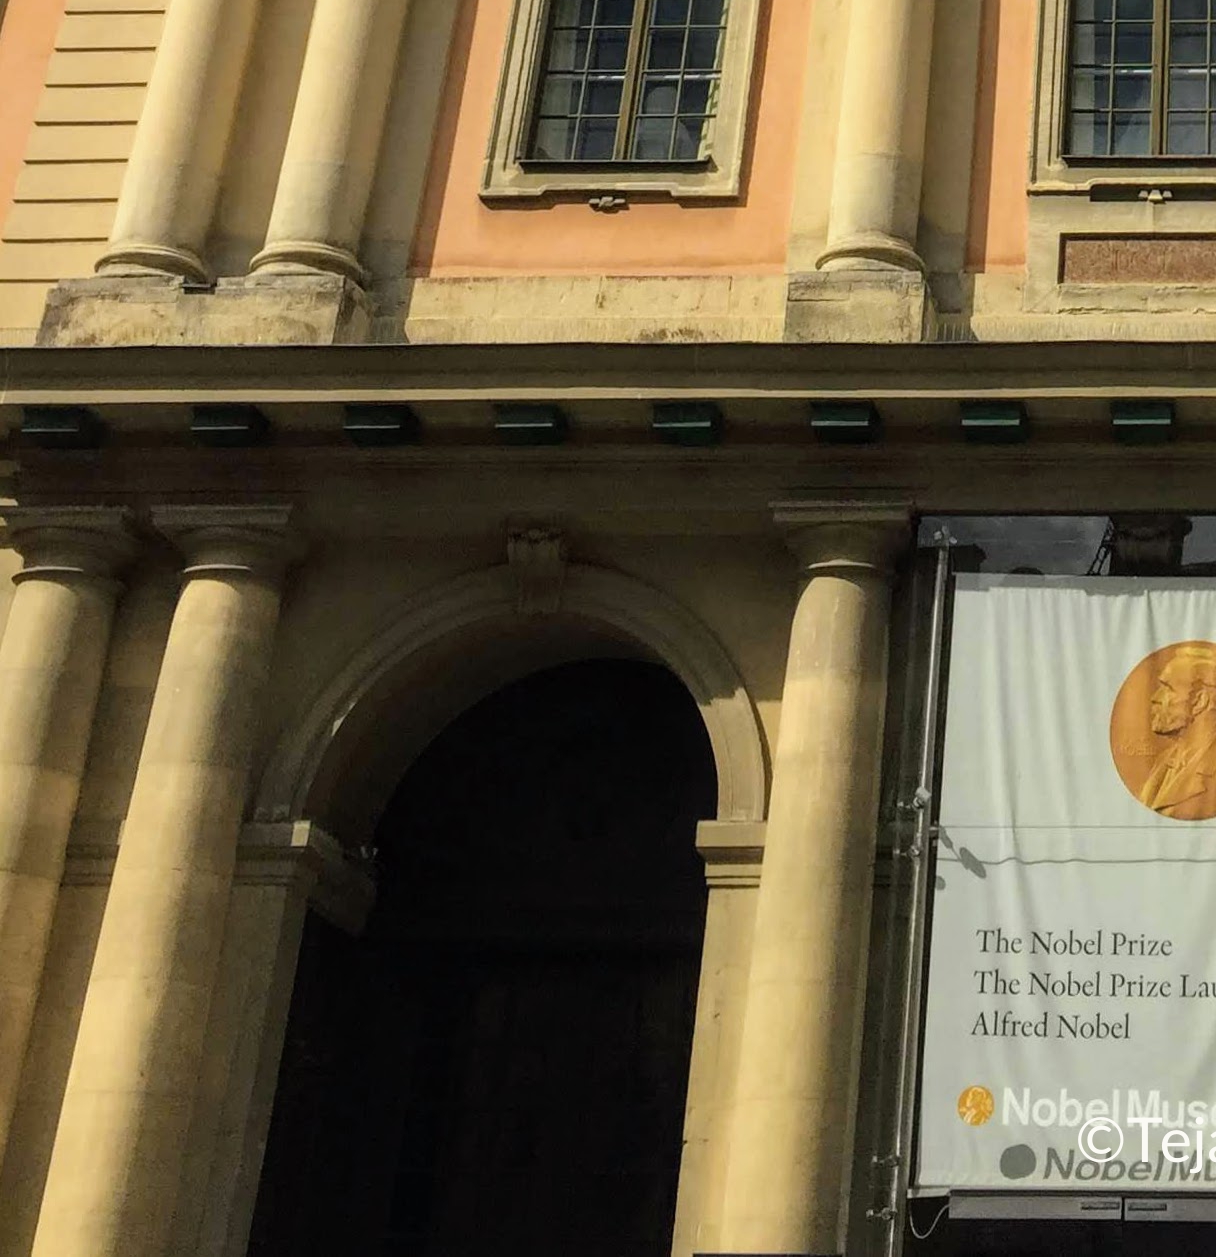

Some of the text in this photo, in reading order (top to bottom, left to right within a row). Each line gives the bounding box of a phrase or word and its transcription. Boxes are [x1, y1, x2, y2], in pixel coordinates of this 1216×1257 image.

[976, 928, 1173, 956] The Nobel Prize
[974, 969, 1020, 995] The
[1028, 970, 1101, 997] Nobel
[1109, 973, 1171, 998] Prize
[971, 1010, 1131, 1039] Alfred Nobel
